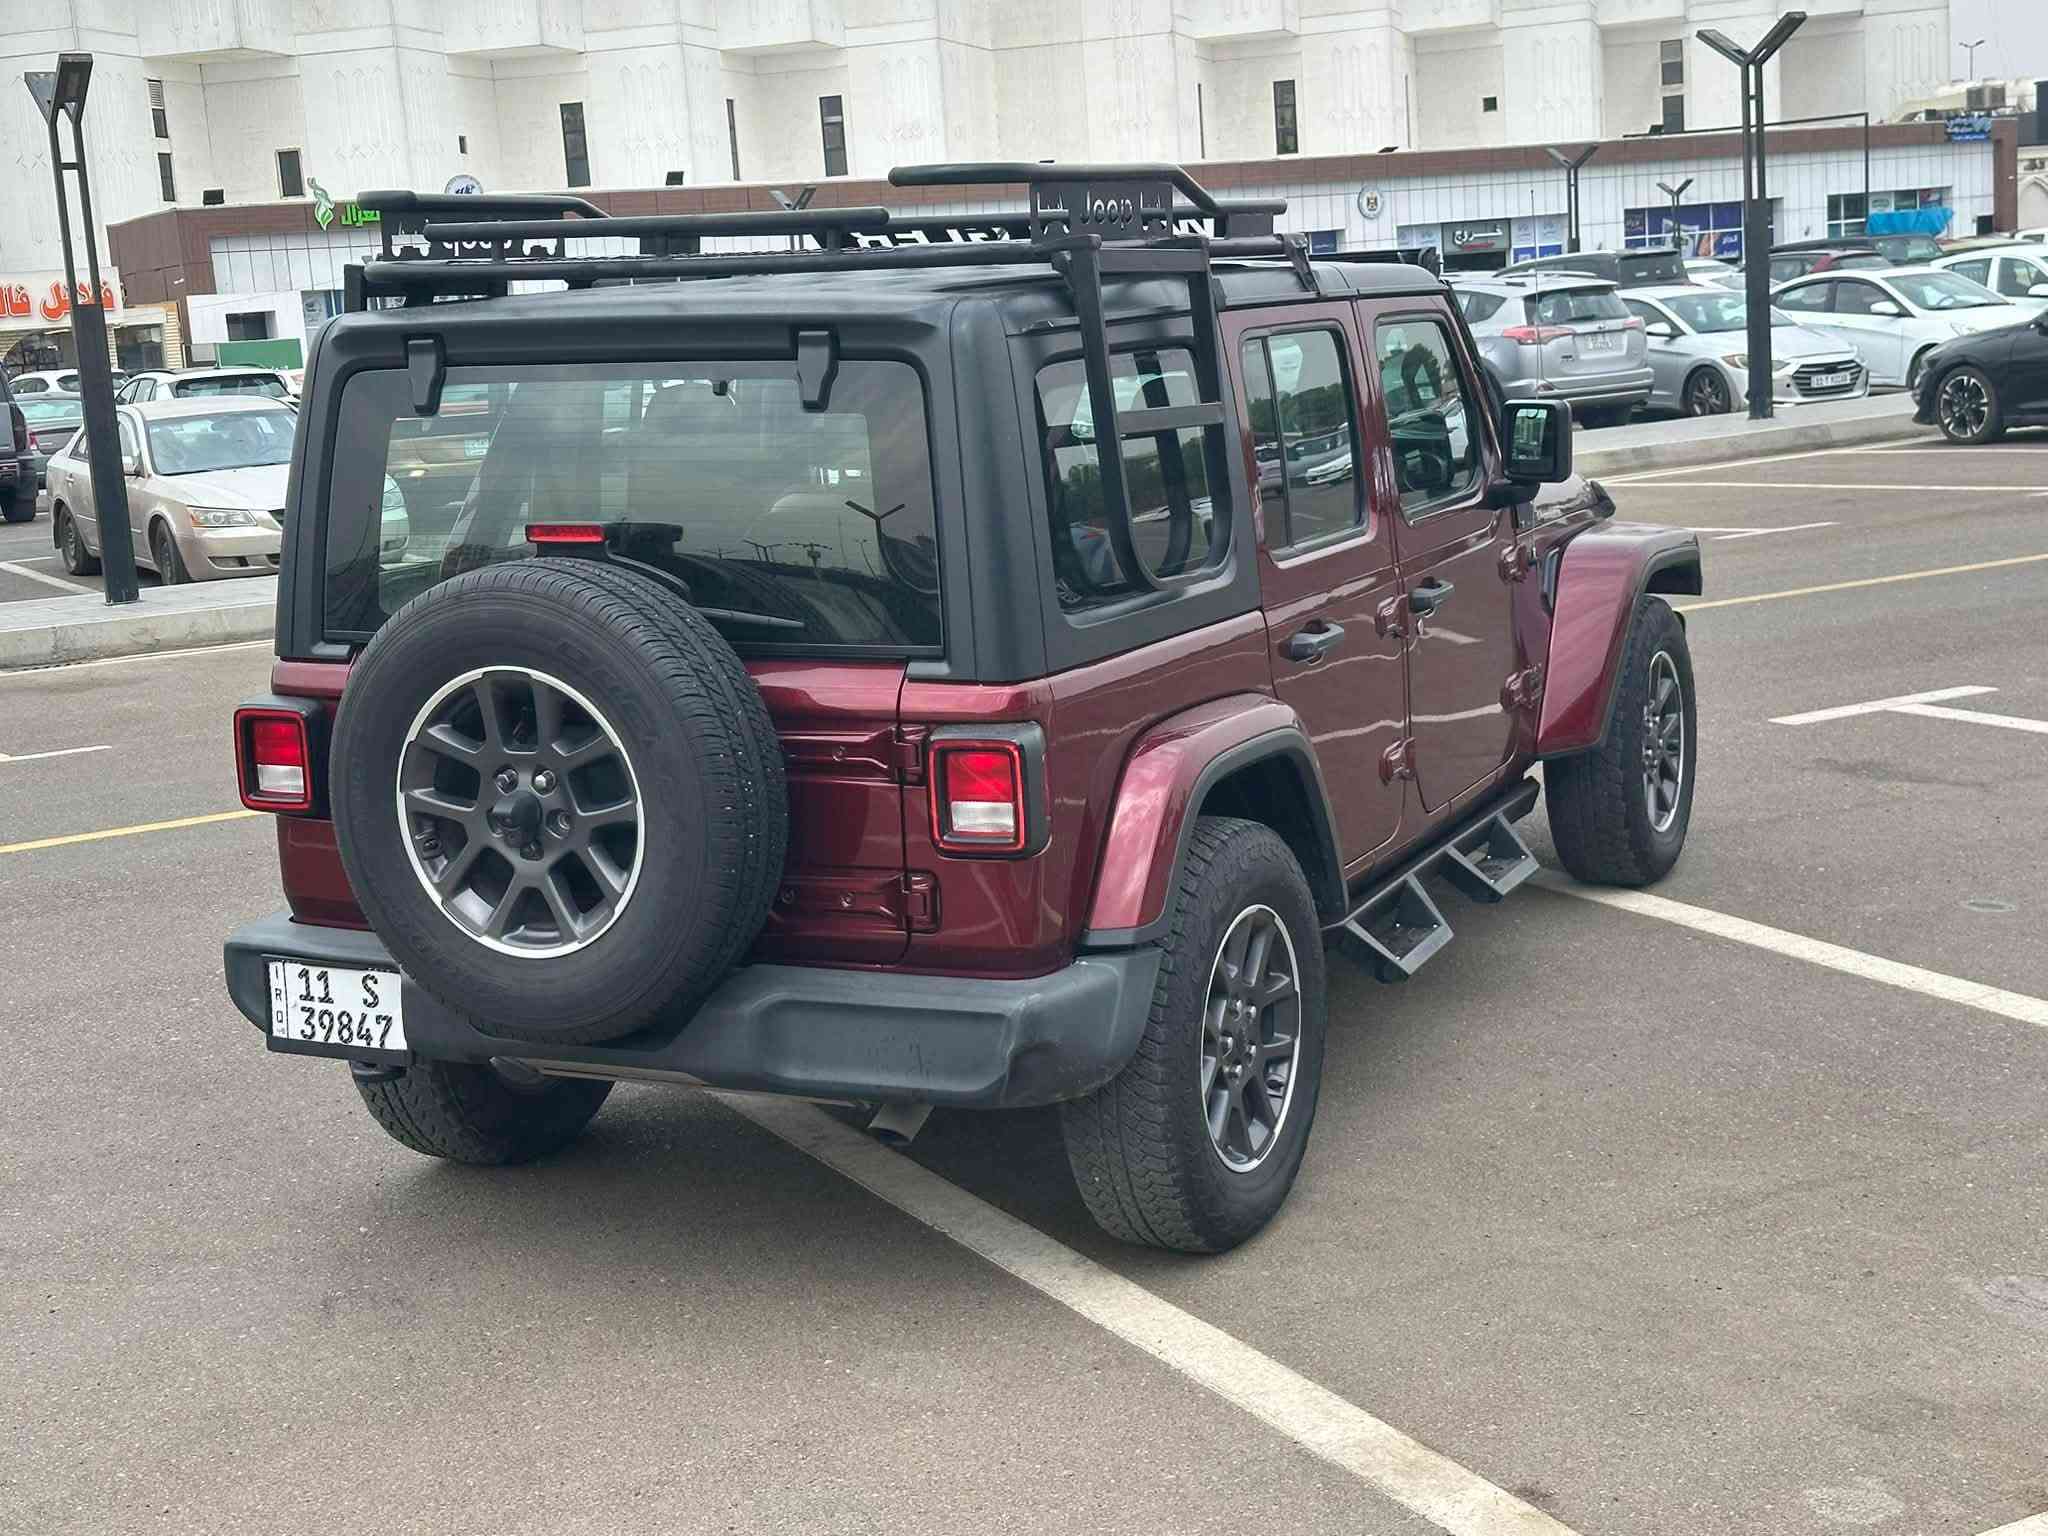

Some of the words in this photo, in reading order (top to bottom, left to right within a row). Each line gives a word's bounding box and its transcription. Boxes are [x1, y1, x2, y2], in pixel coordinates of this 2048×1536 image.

[1080, 190, 1136, 231] Jeep
[1453, 223, 1504, 245] خروج
[298, 967, 335, 1005] 11
[362, 973, 380, 1009] S
[300, 1006, 393, 1049] 39847
